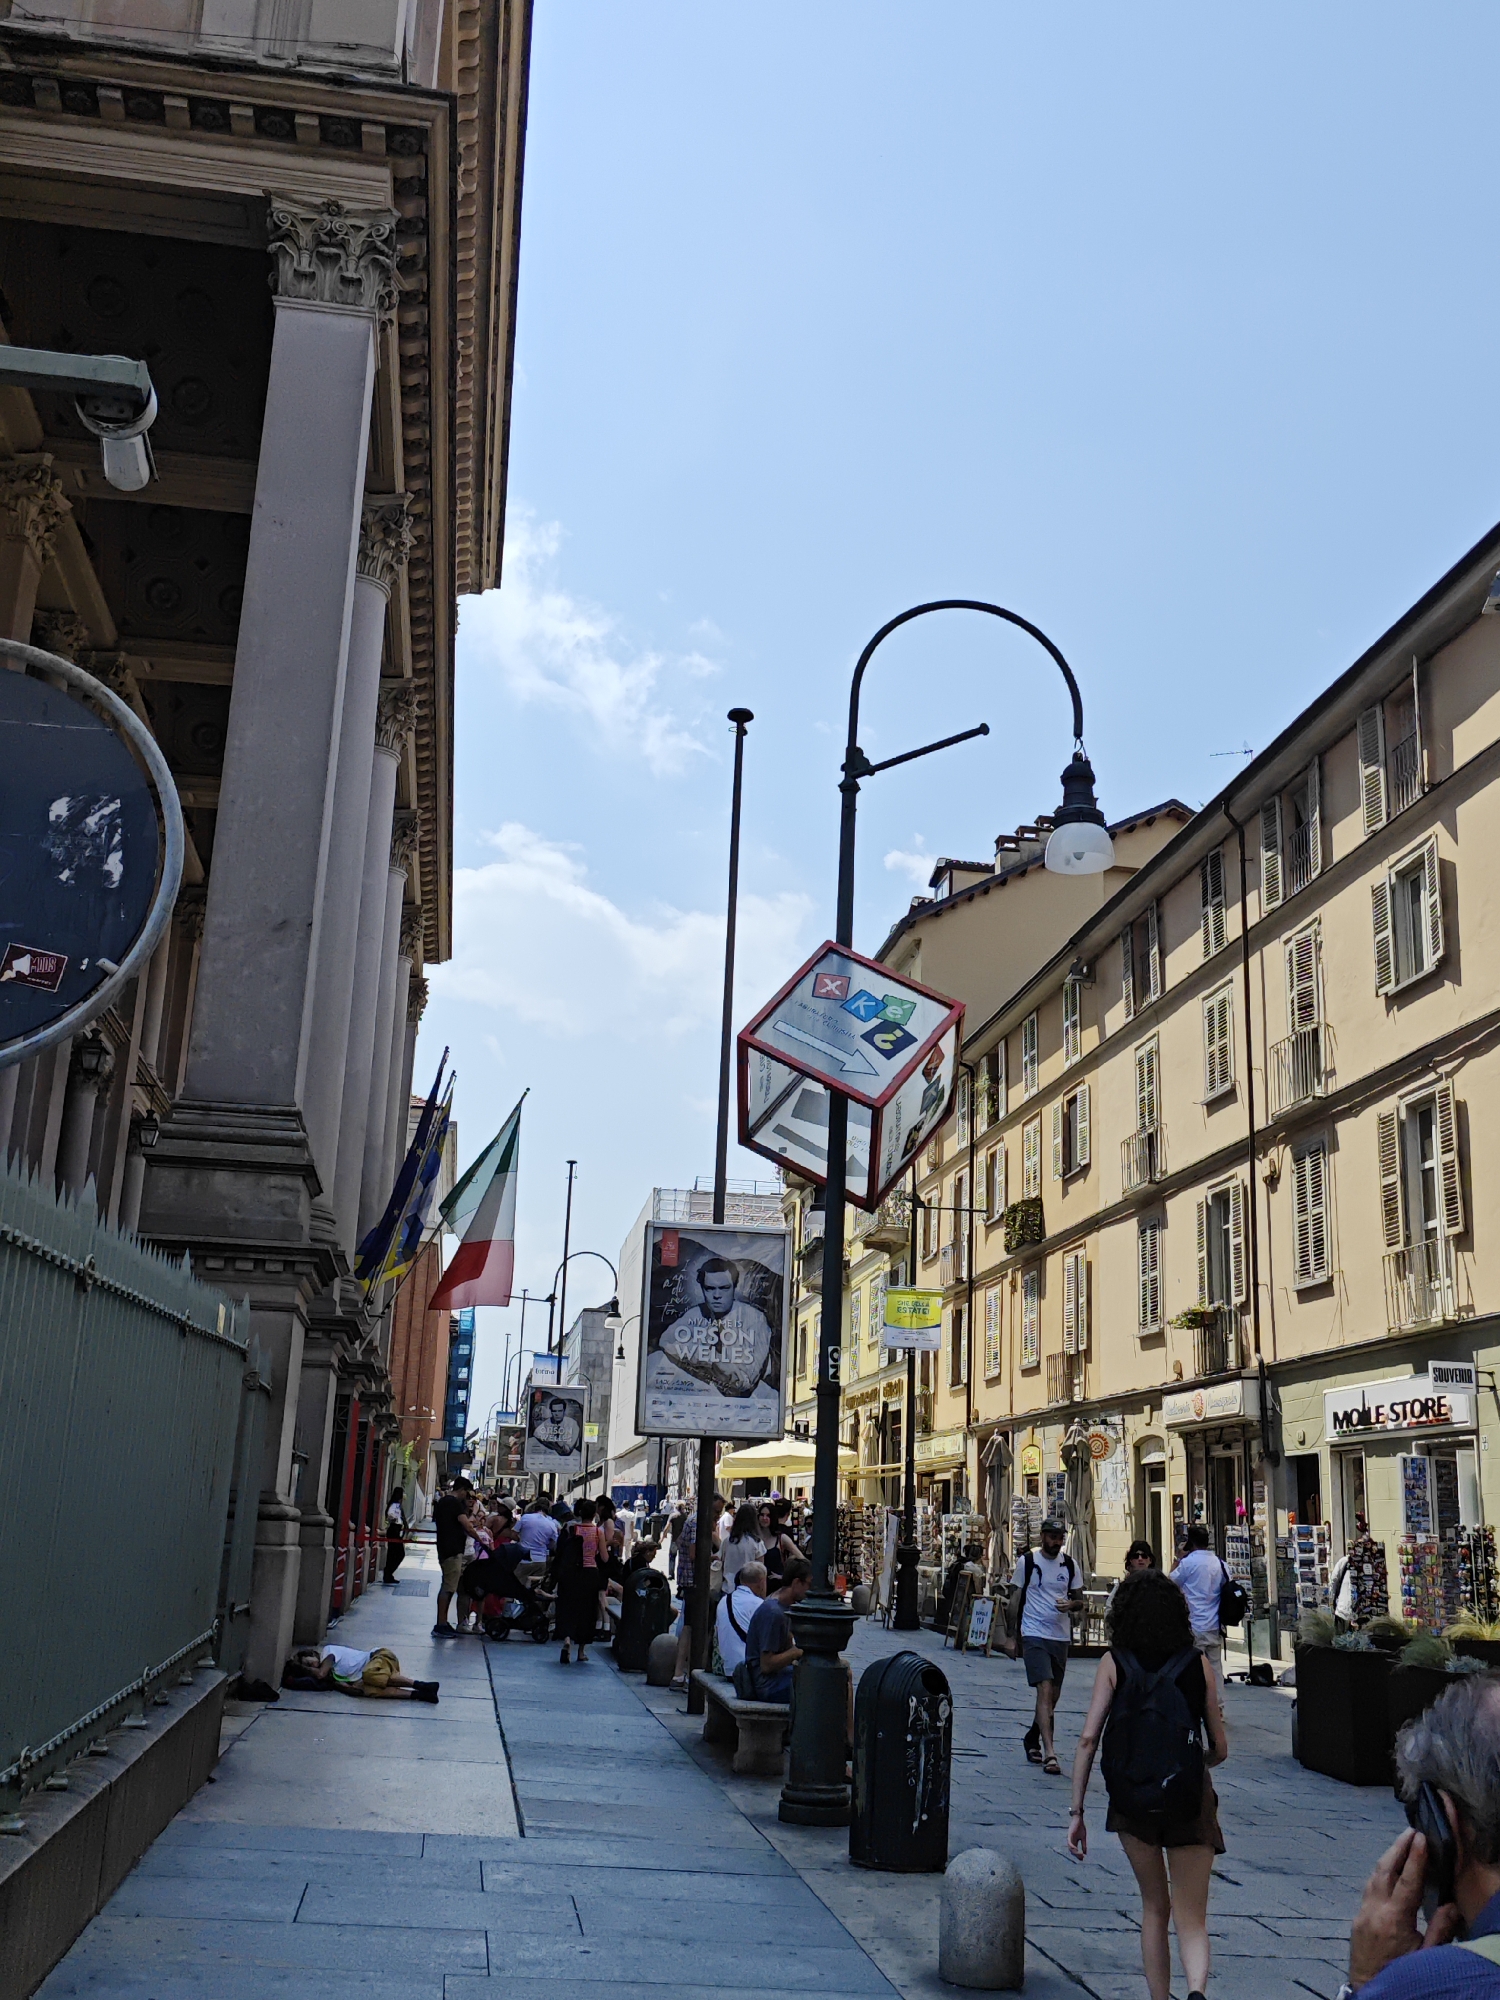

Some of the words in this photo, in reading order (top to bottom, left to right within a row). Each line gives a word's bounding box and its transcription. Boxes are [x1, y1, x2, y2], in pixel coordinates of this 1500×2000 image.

[688, 1317, 703, 1327] MY
[706, 1318, 733, 1328] NAME
[674, 1325, 756, 1346] ORSON
[674, 1344, 755, 1365] WELLES
[1432, 1367, 1474, 1384] SOUVENIR
[1389, 1395, 1448, 1422] STORE
